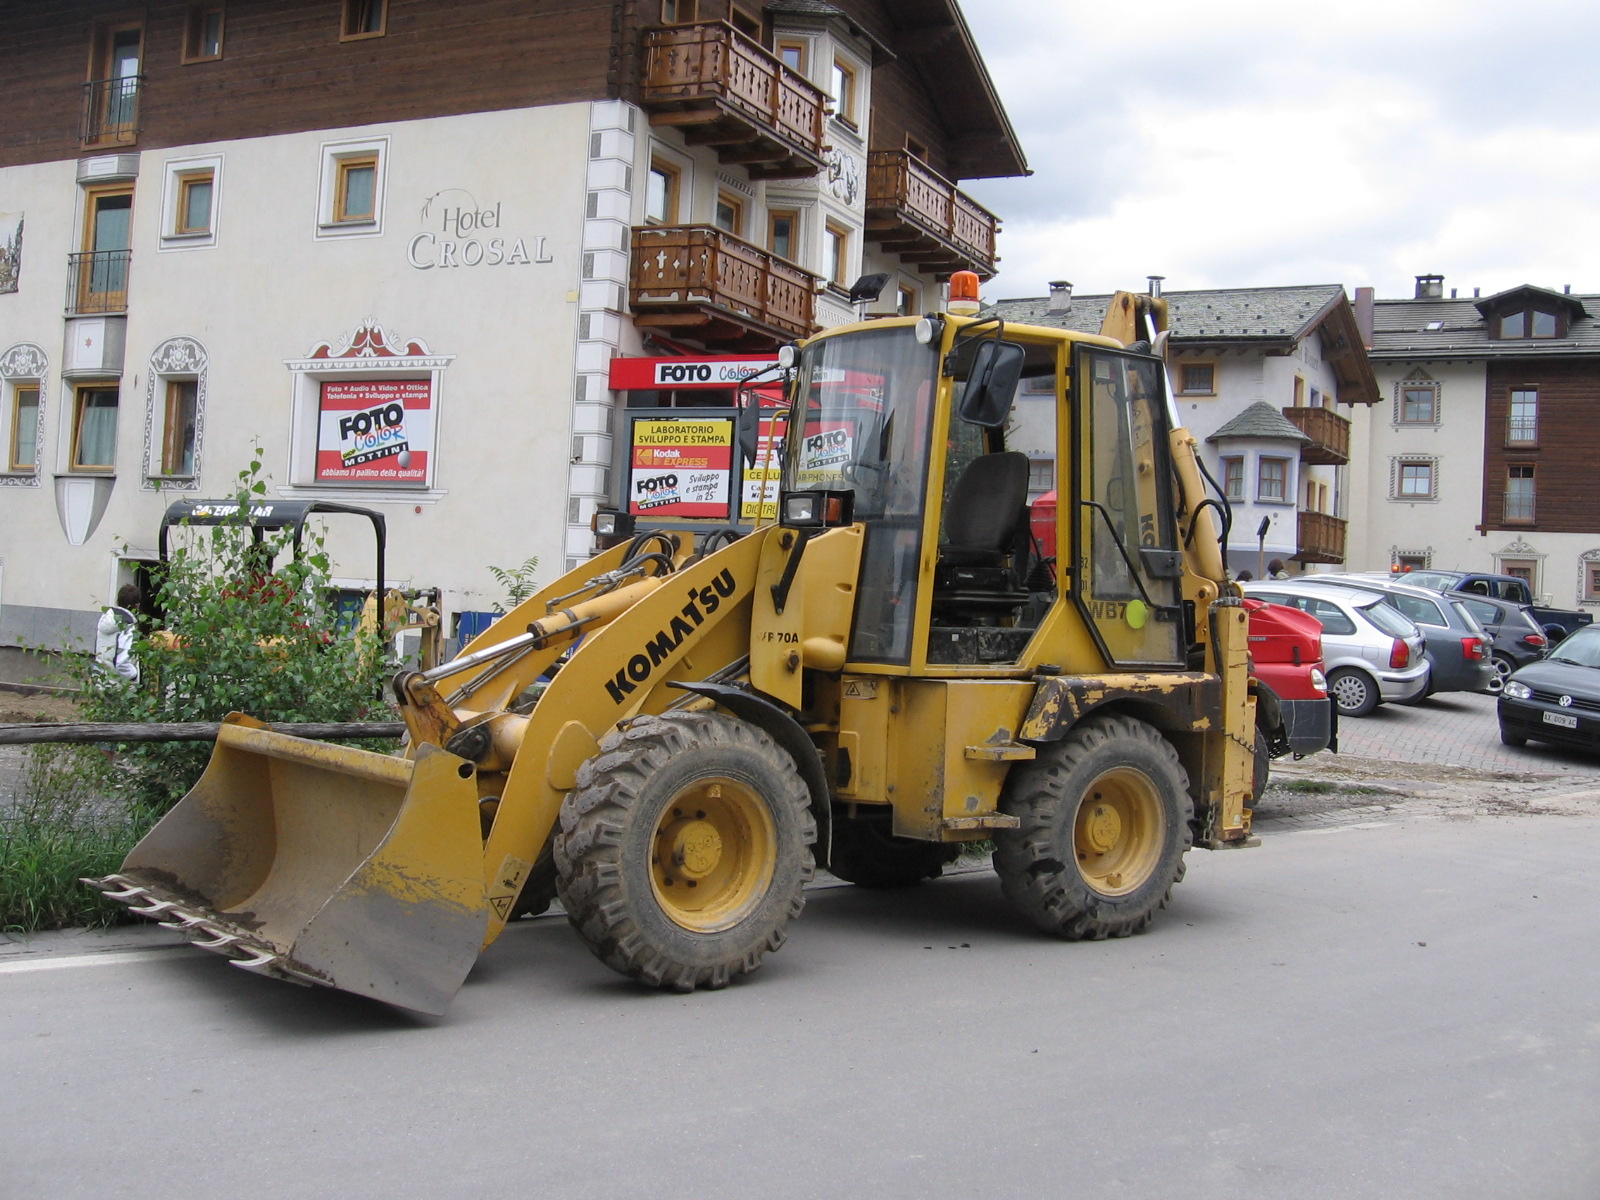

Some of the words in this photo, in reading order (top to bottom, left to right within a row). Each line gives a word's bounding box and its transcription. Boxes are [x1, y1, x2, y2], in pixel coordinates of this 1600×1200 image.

[442, 200, 501, 239] Hotel
[406, 231, 554, 270] CROSAL
[660, 364, 712, 382] FOTO
[327, 385, 342, 393] Foto
[364, 392, 394, 400] Sviluppo
[401, 392, 429, 400] stampa
[339, 403, 404, 441] FOTO
[650, 425, 714, 434] LABORATORIO
[638, 435, 681, 444] SVILUPPO
[683, 435, 689, 444] E
[690, 435, 726, 444] STAMPA
[806, 431, 848, 453] FOTO
[343, 446, 407, 468] MOTTINI
[653, 449, 681, 458] Kodak
[663, 457, 709, 466] EXPRESS
[807, 455, 849, 469] MOTTINI
[321, 468, 349, 477] abbiamo
[350, 468, 356, 477] il
[356, 468, 379, 478] pallino
[380, 468, 397, 477] della
[397, 468, 425, 478] qualità!
[688, 473, 720, 484] Sviluppo
[636, 473, 678, 494] FOTO
[692, 482, 719, 493] stampa
[695, 493, 703, 502] in
[639, 497, 681, 510] MOTTINI
[745, 504, 776, 515] DIGTAL
[604, 568, 737, 706] KOMATSU
[776, 632, 799, 643] 70A
